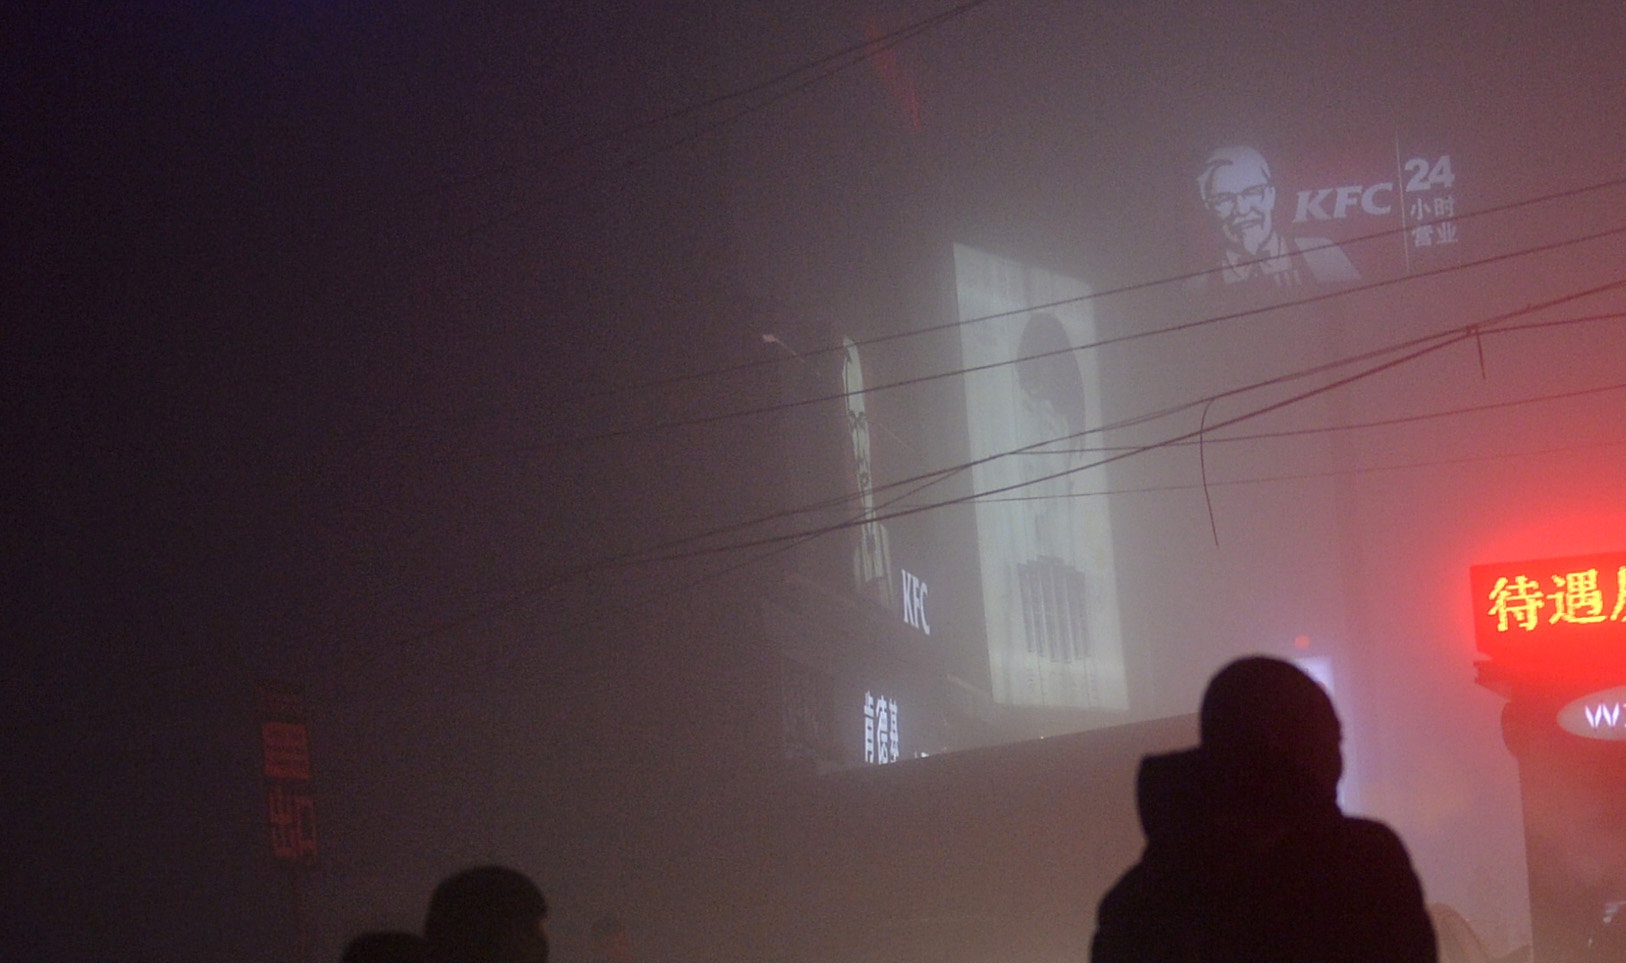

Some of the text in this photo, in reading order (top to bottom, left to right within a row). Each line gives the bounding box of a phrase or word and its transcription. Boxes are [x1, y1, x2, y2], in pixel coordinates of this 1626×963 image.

[1404, 155, 1456, 193] 24
[1292, 182, 1393, 224] KFC
[1410, 195, 1455, 220] 小时
[1411, 221, 1459, 248] 营业
[901, 569, 931, 636] KFC
[864, 690, 900, 765] 肯德基
